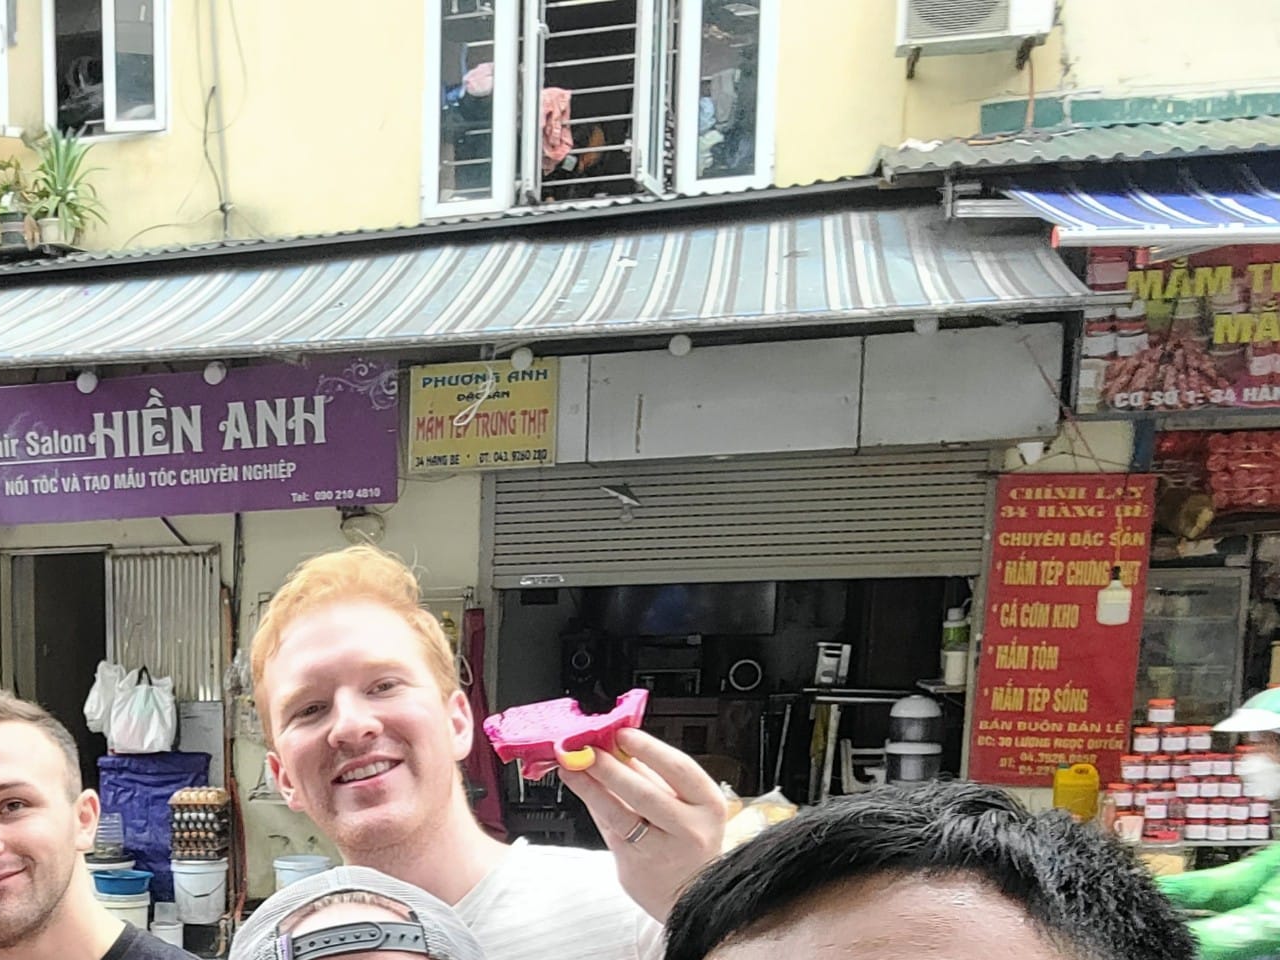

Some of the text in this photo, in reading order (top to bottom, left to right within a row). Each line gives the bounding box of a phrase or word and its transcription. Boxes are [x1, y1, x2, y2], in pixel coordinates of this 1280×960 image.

[507, 369, 549, 383] ANH
[25, 430, 87, 458] Salon
[89, 388, 204, 458] HIỀN
[219, 395, 334, 450] ANH
[83, 474, 110, 495] TẠO
[149, 467, 177, 487] TÓC
[180, 464, 238, 486] CHUYÊN
[242, 459, 297, 483] NGHIỆP
[1000, 505, 1027, 518] 34
[1052, 604, 1080, 628] KHO
[979, 719, 1012, 731] BÁN
[1067, 720, 1100, 733] BÁN
